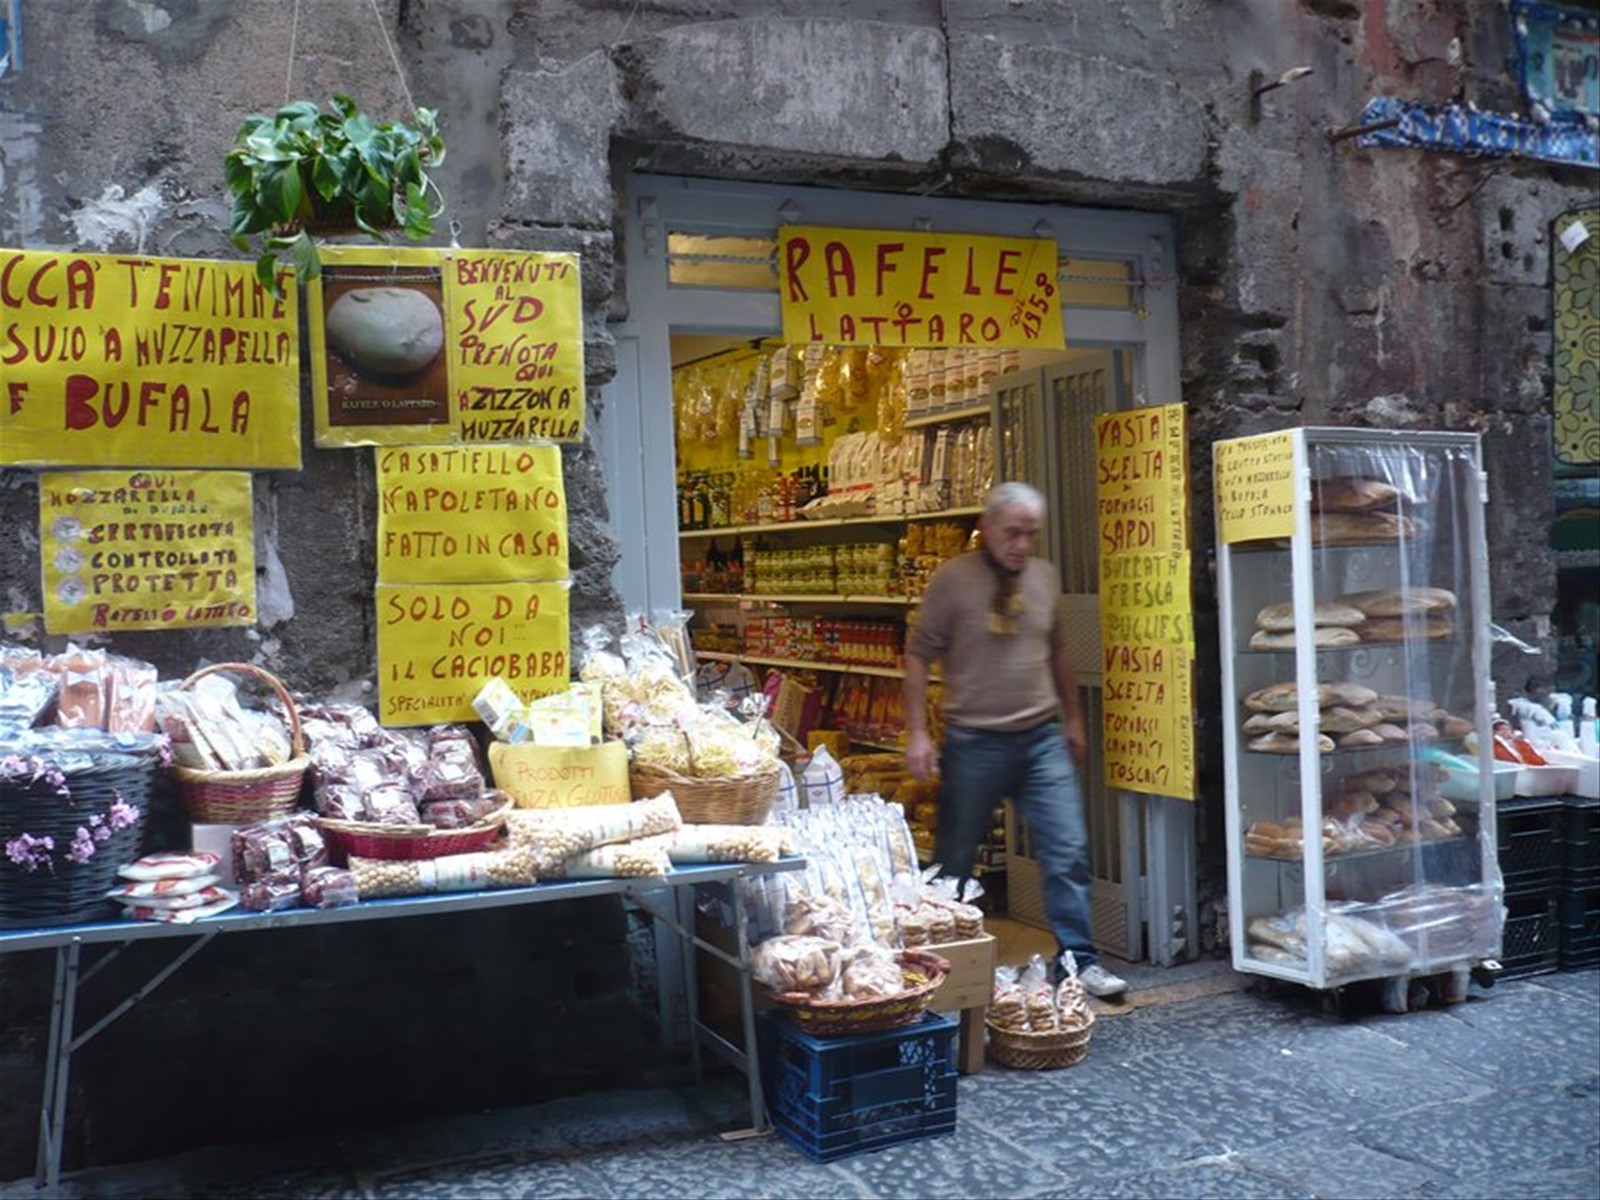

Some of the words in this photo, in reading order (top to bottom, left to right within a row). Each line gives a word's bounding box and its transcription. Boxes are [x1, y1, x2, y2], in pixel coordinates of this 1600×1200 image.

[456, 257, 568, 285] BENVENUTI
[786, 237, 1022, 302] RAFELE
[495, 285, 514, 301] AL
[1022, 272, 1055, 340] 1958
[809, 312, 1001, 344] LATTARO
[459, 334, 558, 365] PRENOTA
[514, 363, 554, 382] QUI
[65, 374, 250, 436] BUFALA
[461, 411, 580, 441] MUZZARELLA
[1097, 415, 1160, 450] VASTA
[381, 449, 535, 475] CASATIELLO
[1098, 450, 1163, 485] SCELTA
[383, 486, 559, 514] NAPOLETANO
[384, 531, 457, 559] FATTO
[466, 534, 490, 555] IN
[498, 531, 560, 559] CASA
[92, 570, 238, 595] PROTETTA
[386, 594, 470, 625] SOLO
[492, 594, 541, 621] DA
[392, 660, 415, 681] IL
[432, 650, 565, 679] CACIOBABA
[1105, 646, 1163, 673] VASTA
[1105, 679, 1165, 705] SCELTA
